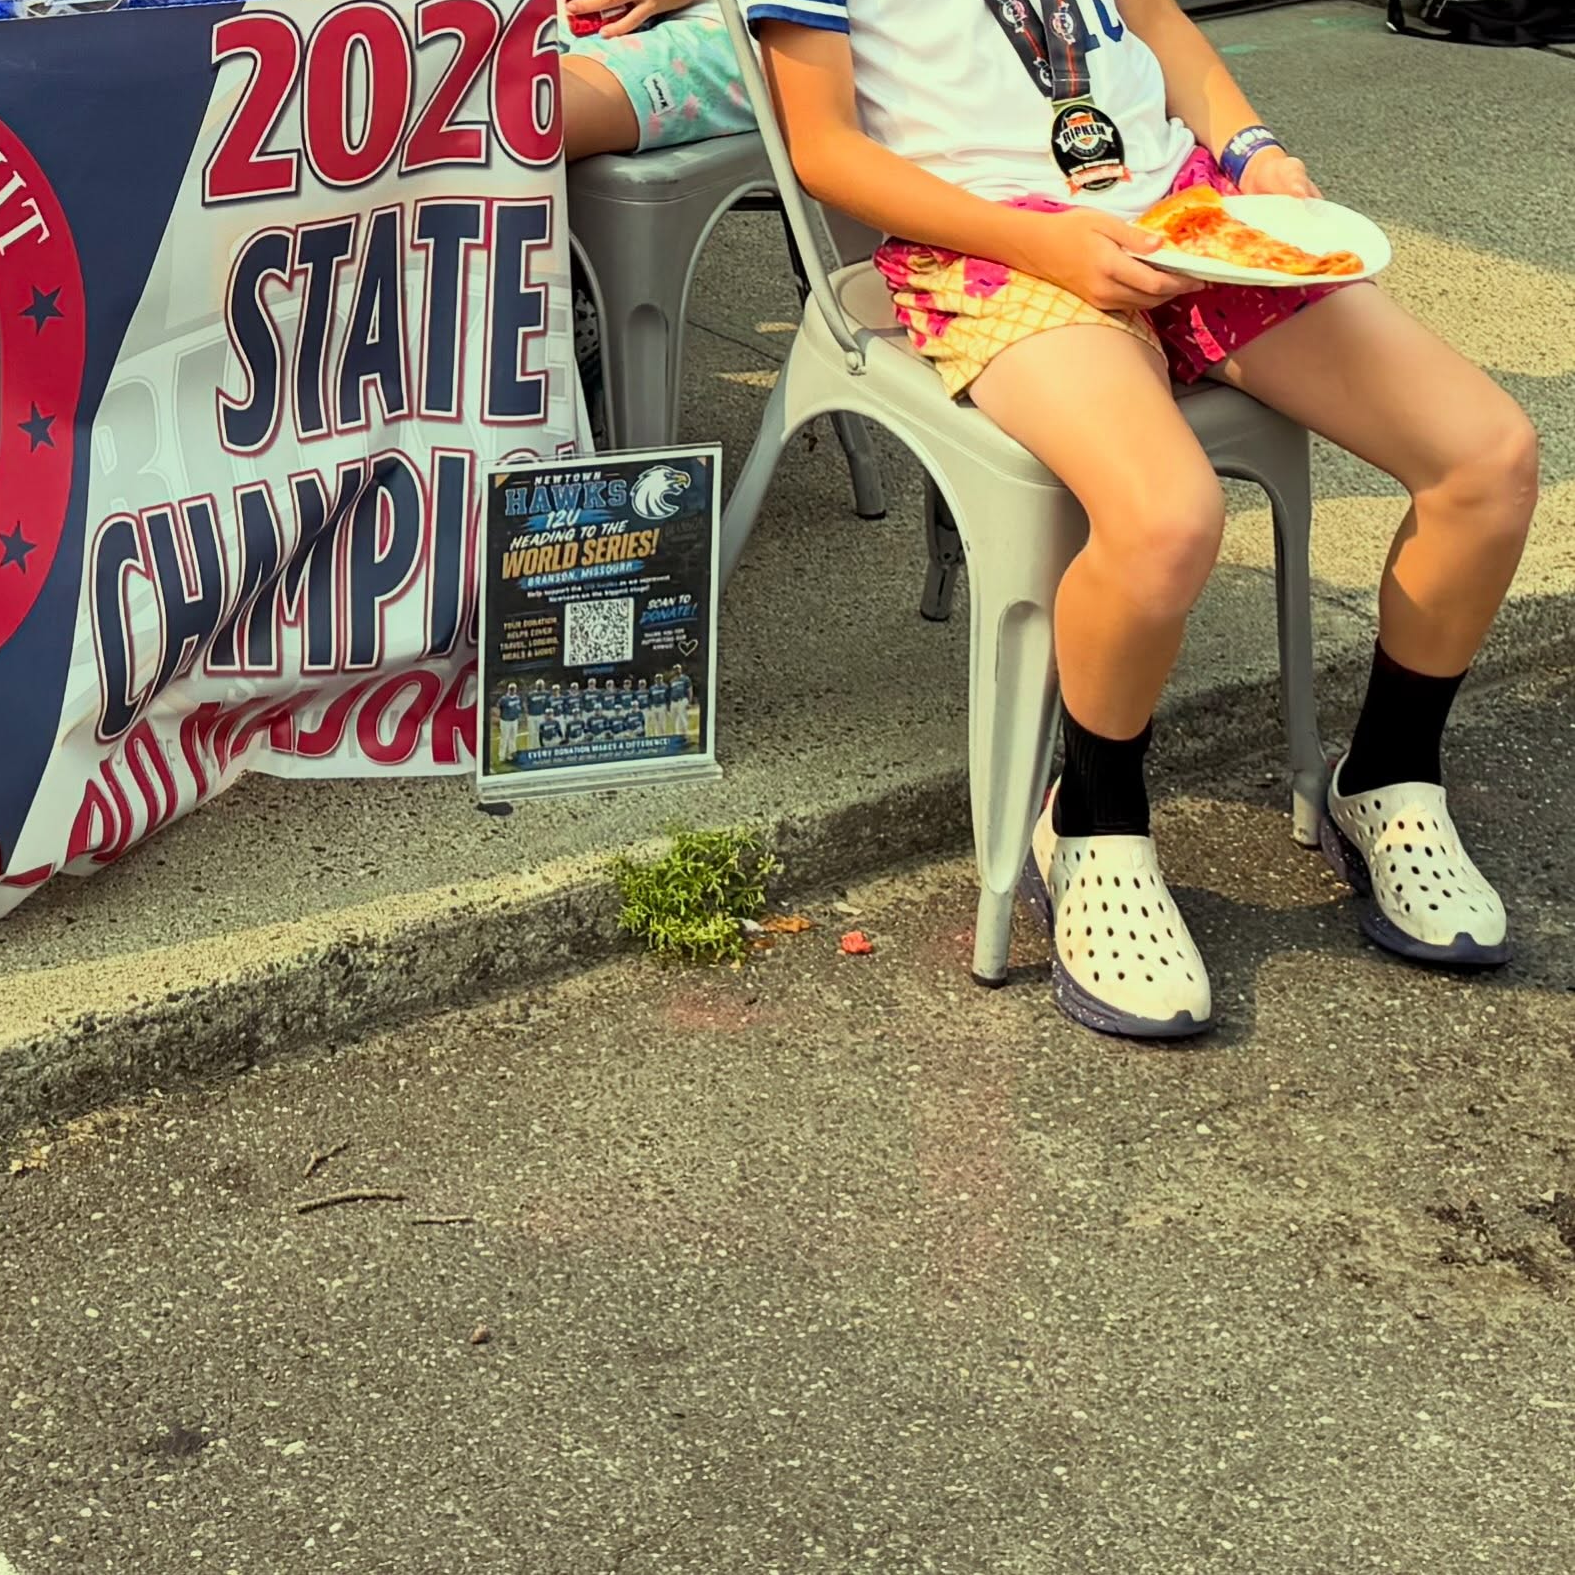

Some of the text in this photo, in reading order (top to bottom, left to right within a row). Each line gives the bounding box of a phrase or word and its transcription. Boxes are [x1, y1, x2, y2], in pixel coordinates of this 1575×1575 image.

[214, 196, 555, 457] STATE
[534, 471, 602, 485] NEWTOWN
[505, 479, 627, 516] HAWKS
[509, 520, 629, 551] HEADING TO THE
[545, 508, 583, 529] 12U
[502, 528, 661, 580] WORLD SERIES!
[90, 443, 575, 744] CHAMPI
[647, 594, 692, 610] SCAN TO
